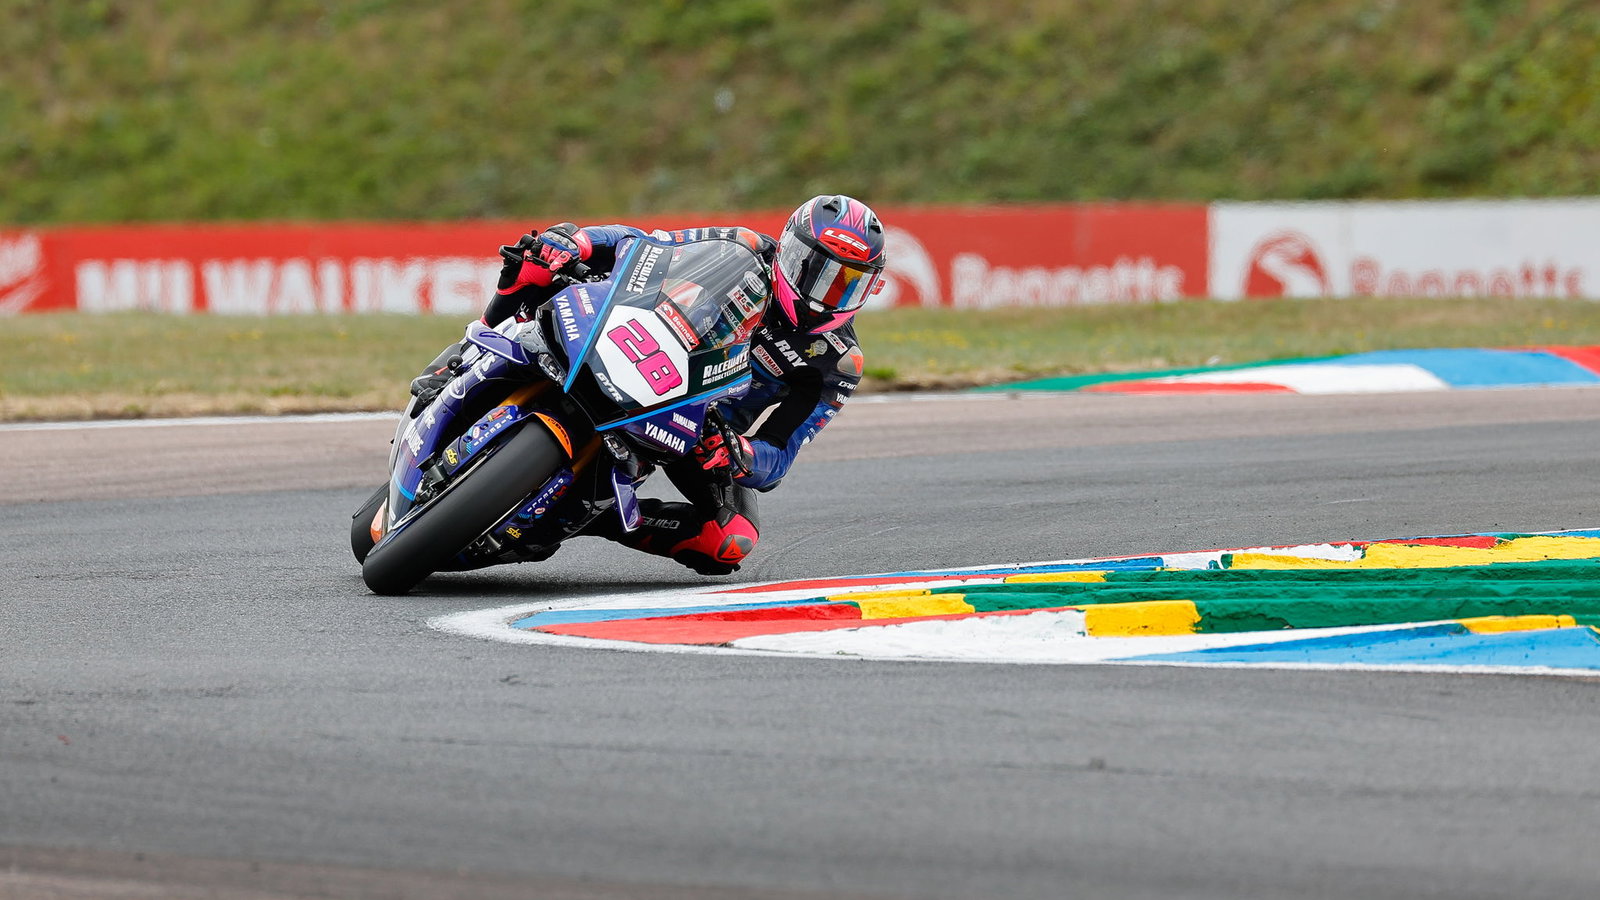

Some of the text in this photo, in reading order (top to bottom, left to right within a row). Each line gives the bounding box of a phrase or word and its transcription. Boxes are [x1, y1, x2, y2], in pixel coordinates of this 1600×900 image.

[824, 229, 869, 253] LS2
[633, 246, 664, 295] RACEWAYS
[953, 254, 1184, 308] Bennetts
[1351, 256, 1584, 298] Bennetts
[555, 295, 581, 342] YAMAHA
[607, 318, 683, 396] 28
[703, 350, 750, 379] RACEWAYS
[762, 351, 783, 376] YAMAHA
[774, 339, 808, 368] RAY
[596, 372, 624, 403] GYTR
[473, 414, 514, 446] PIRELLI
[644, 421, 687, 454] YAMAHA
[672, 411, 699, 433] YAMALUBE
[445, 448, 459, 465] sbs
[526, 478, 565, 512] PIRELLI
[506, 526, 523, 539] sbs
[642, 516, 681, 530] DAINE
